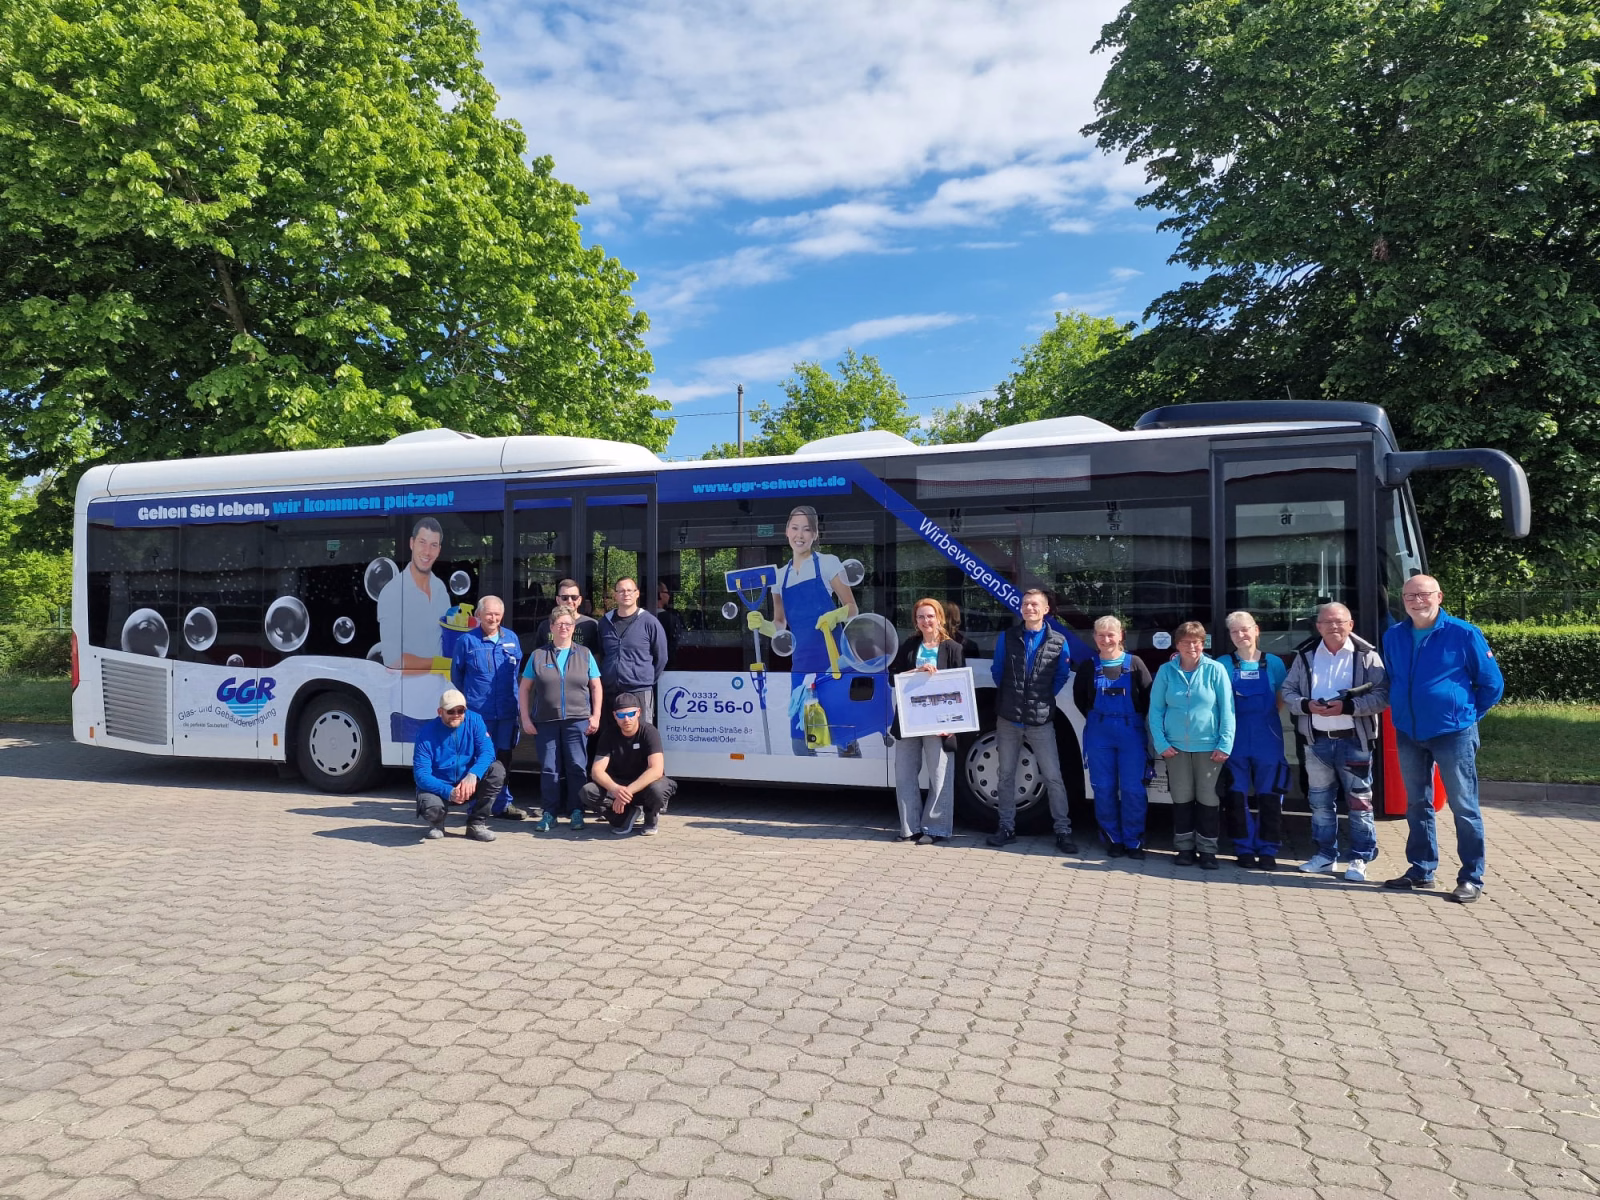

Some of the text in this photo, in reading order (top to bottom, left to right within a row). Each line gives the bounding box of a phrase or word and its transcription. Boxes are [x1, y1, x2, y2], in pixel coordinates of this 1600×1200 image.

[692, 475, 846, 494] www.ggr-schwedt.de
[137, 490, 455, 521] Gehen Sie leben, wir kommen putzen!
[919, 516, 1021, 611] WirbewegenSie.
[216, 676, 277, 705] GGR
[177, 708, 197, 721] Glas-
[214, 706, 278, 728] Gebäudereinigung
[686, 700, 754, 714] 26 56-0
[667, 734, 687, 742] 16303
